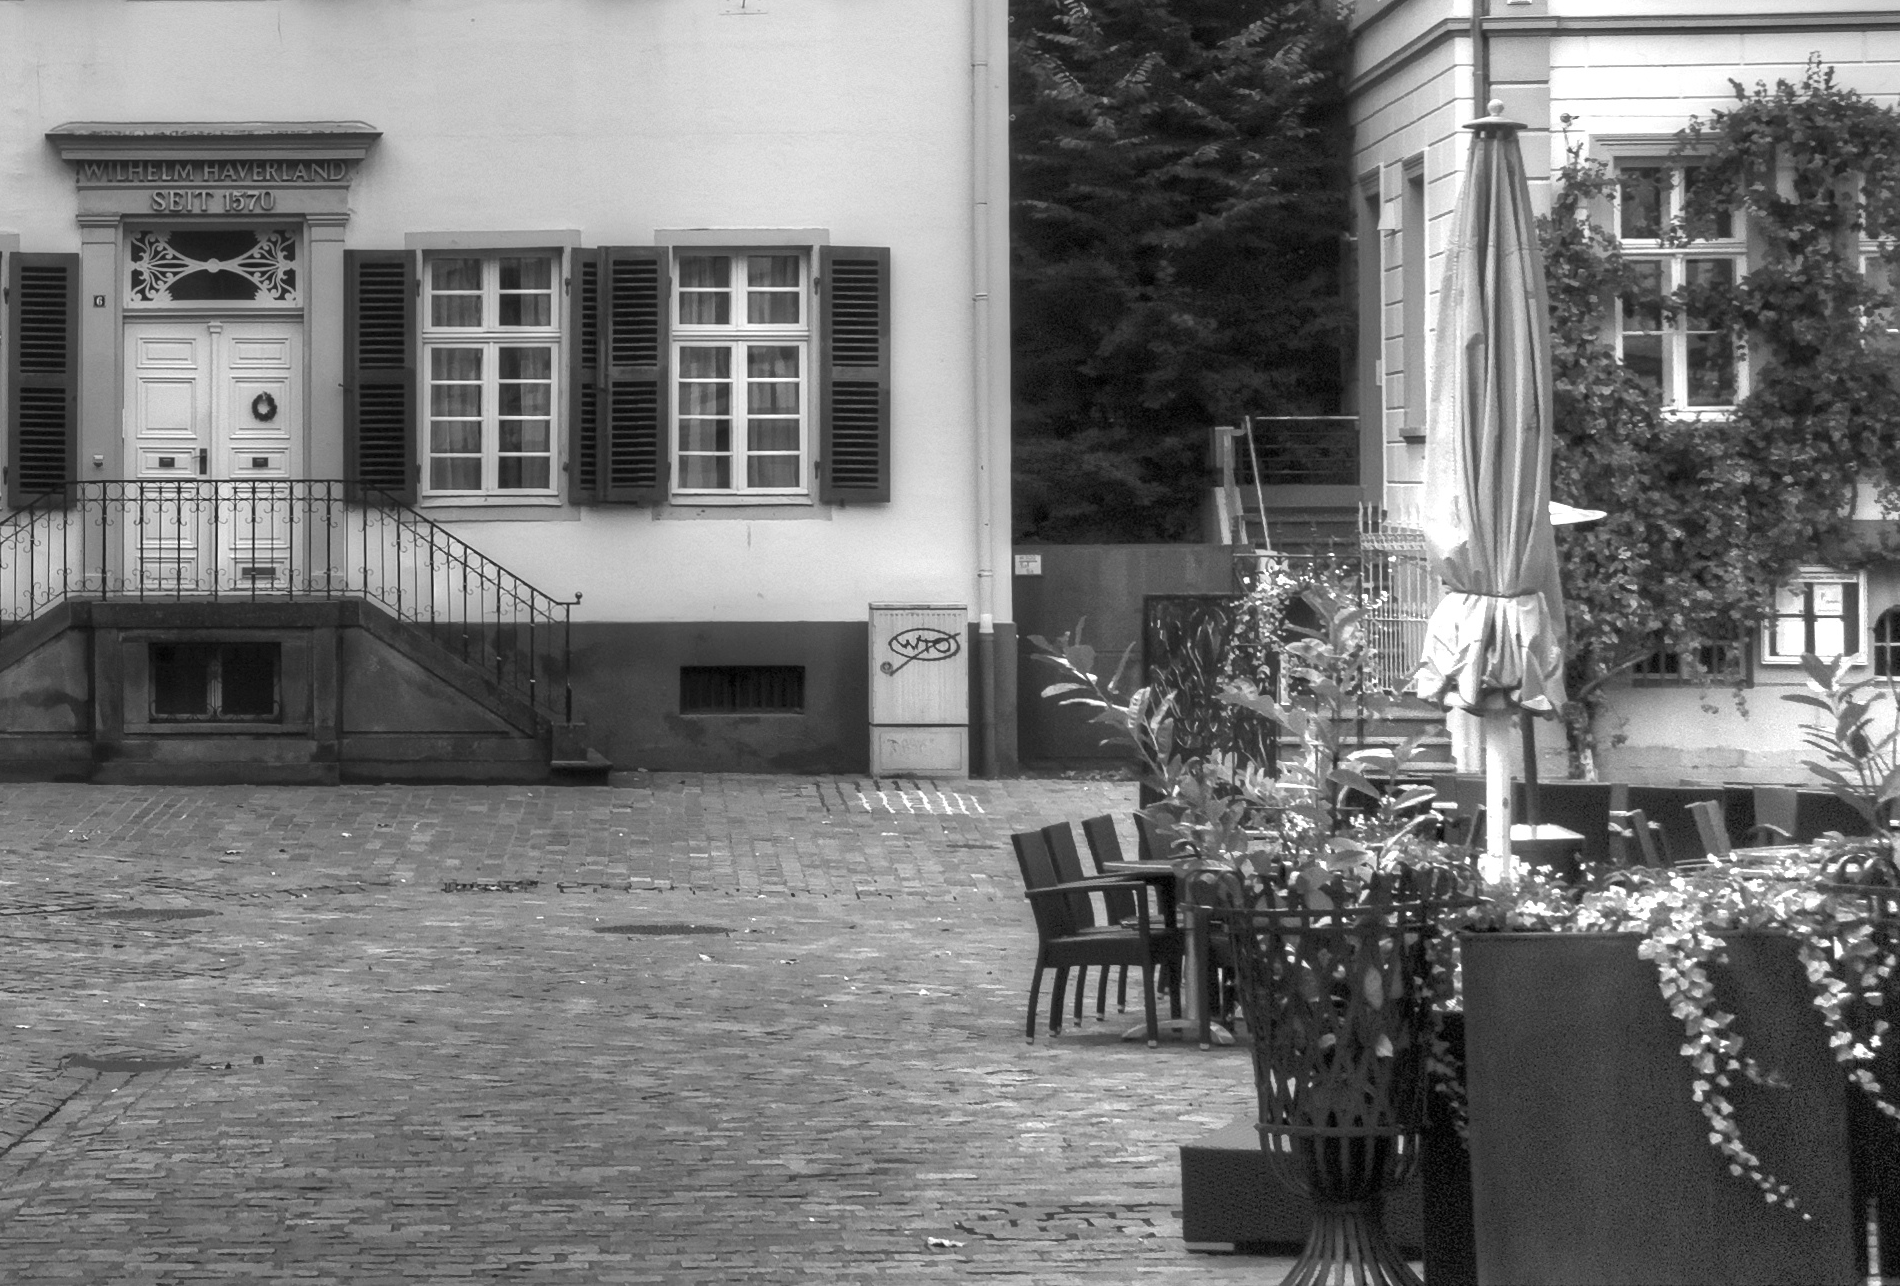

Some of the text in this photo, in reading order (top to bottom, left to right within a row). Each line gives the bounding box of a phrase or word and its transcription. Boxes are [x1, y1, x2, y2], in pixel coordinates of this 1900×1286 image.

[84, 160, 347, 182] WILHELM HAVERLAND
[152, 190, 275, 212] SEIT 1570
[96, 296, 104, 307] 6
